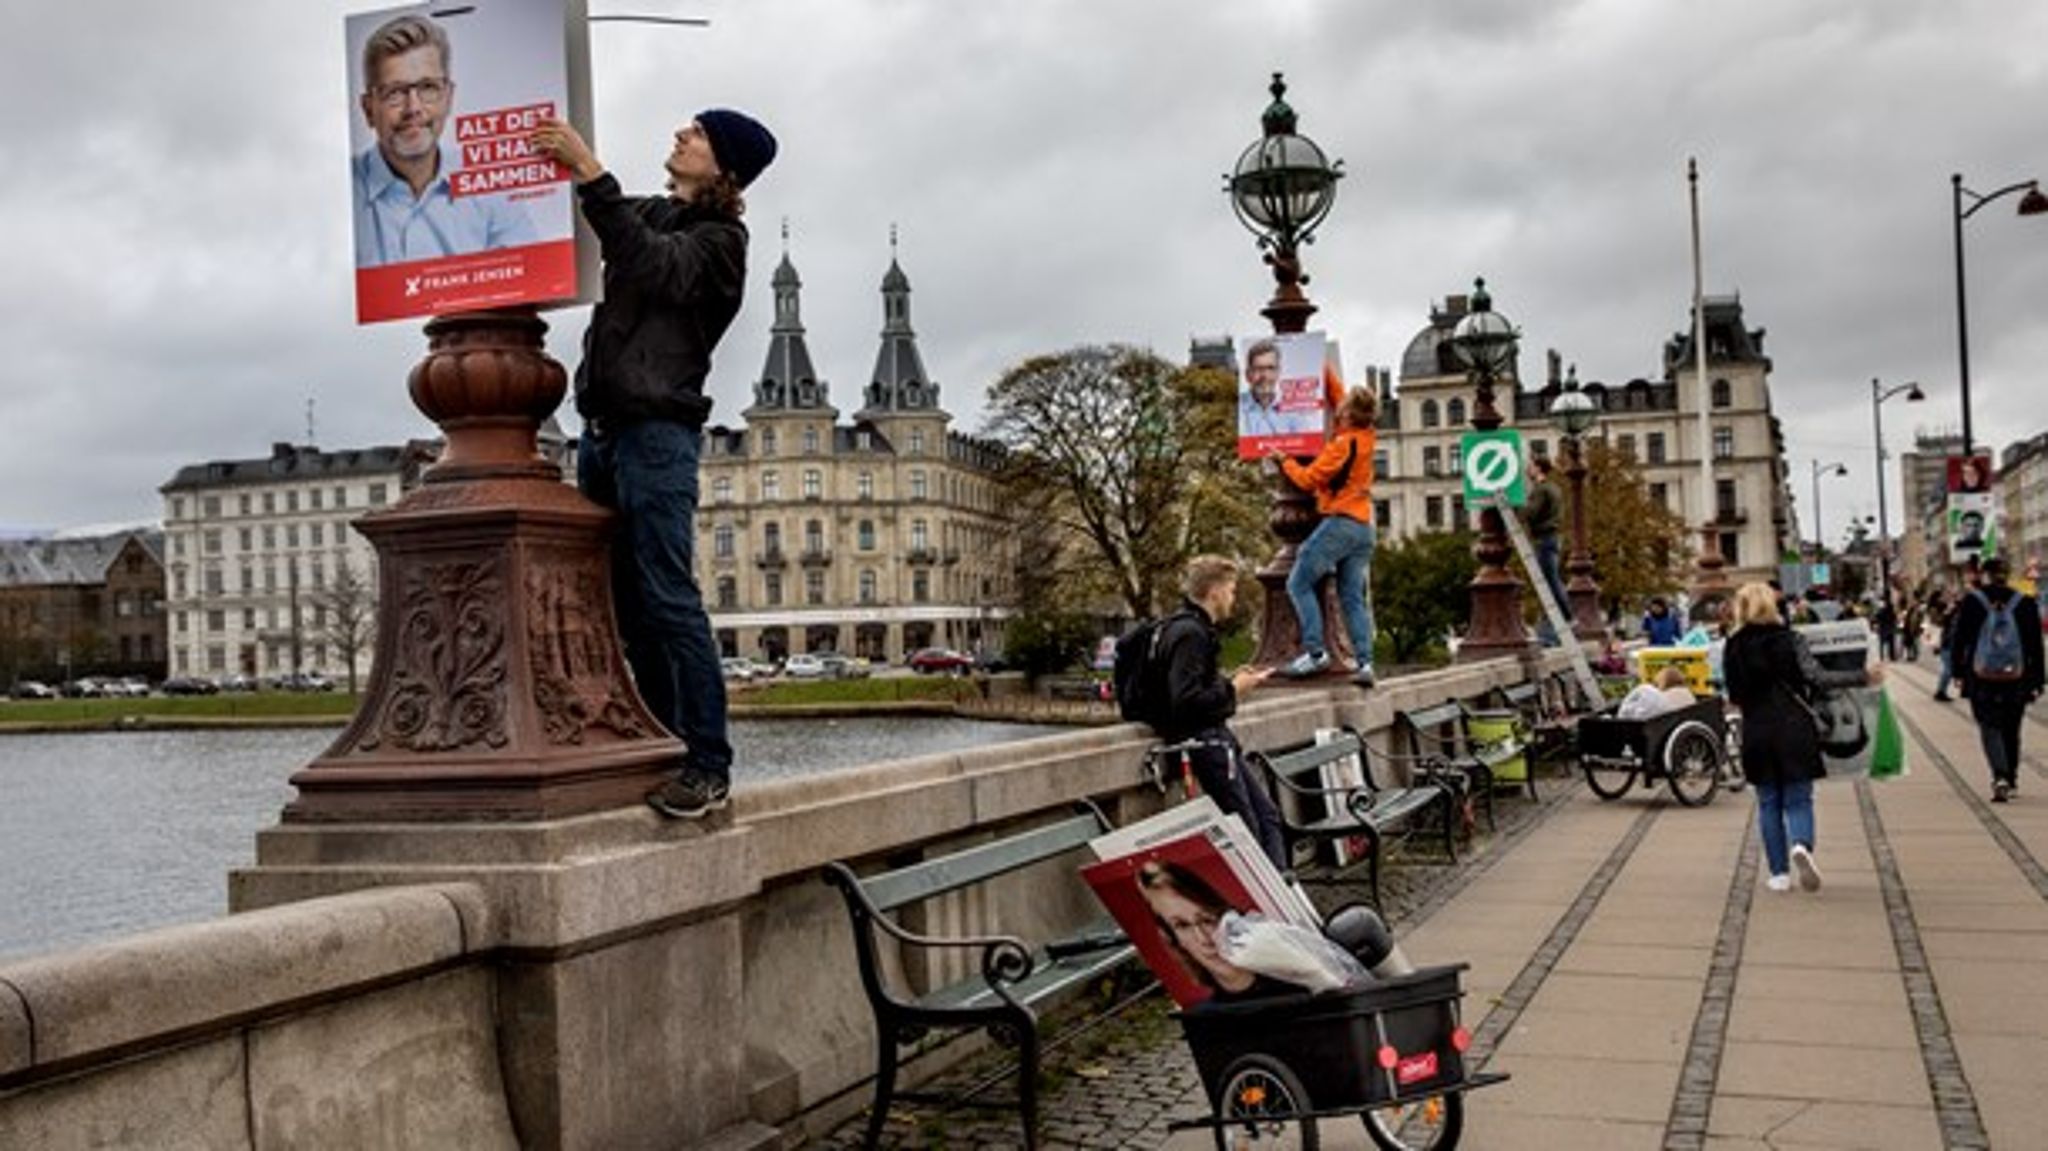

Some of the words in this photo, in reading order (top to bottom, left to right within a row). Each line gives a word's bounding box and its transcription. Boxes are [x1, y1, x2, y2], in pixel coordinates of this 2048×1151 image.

[459, 115, 499, 138] ALT
[467, 144, 491, 163] VI
[458, 162, 556, 193] SAMMEN
[423, 272, 468, 290] FRANK
[472, 265, 525, 284] JENSEN
